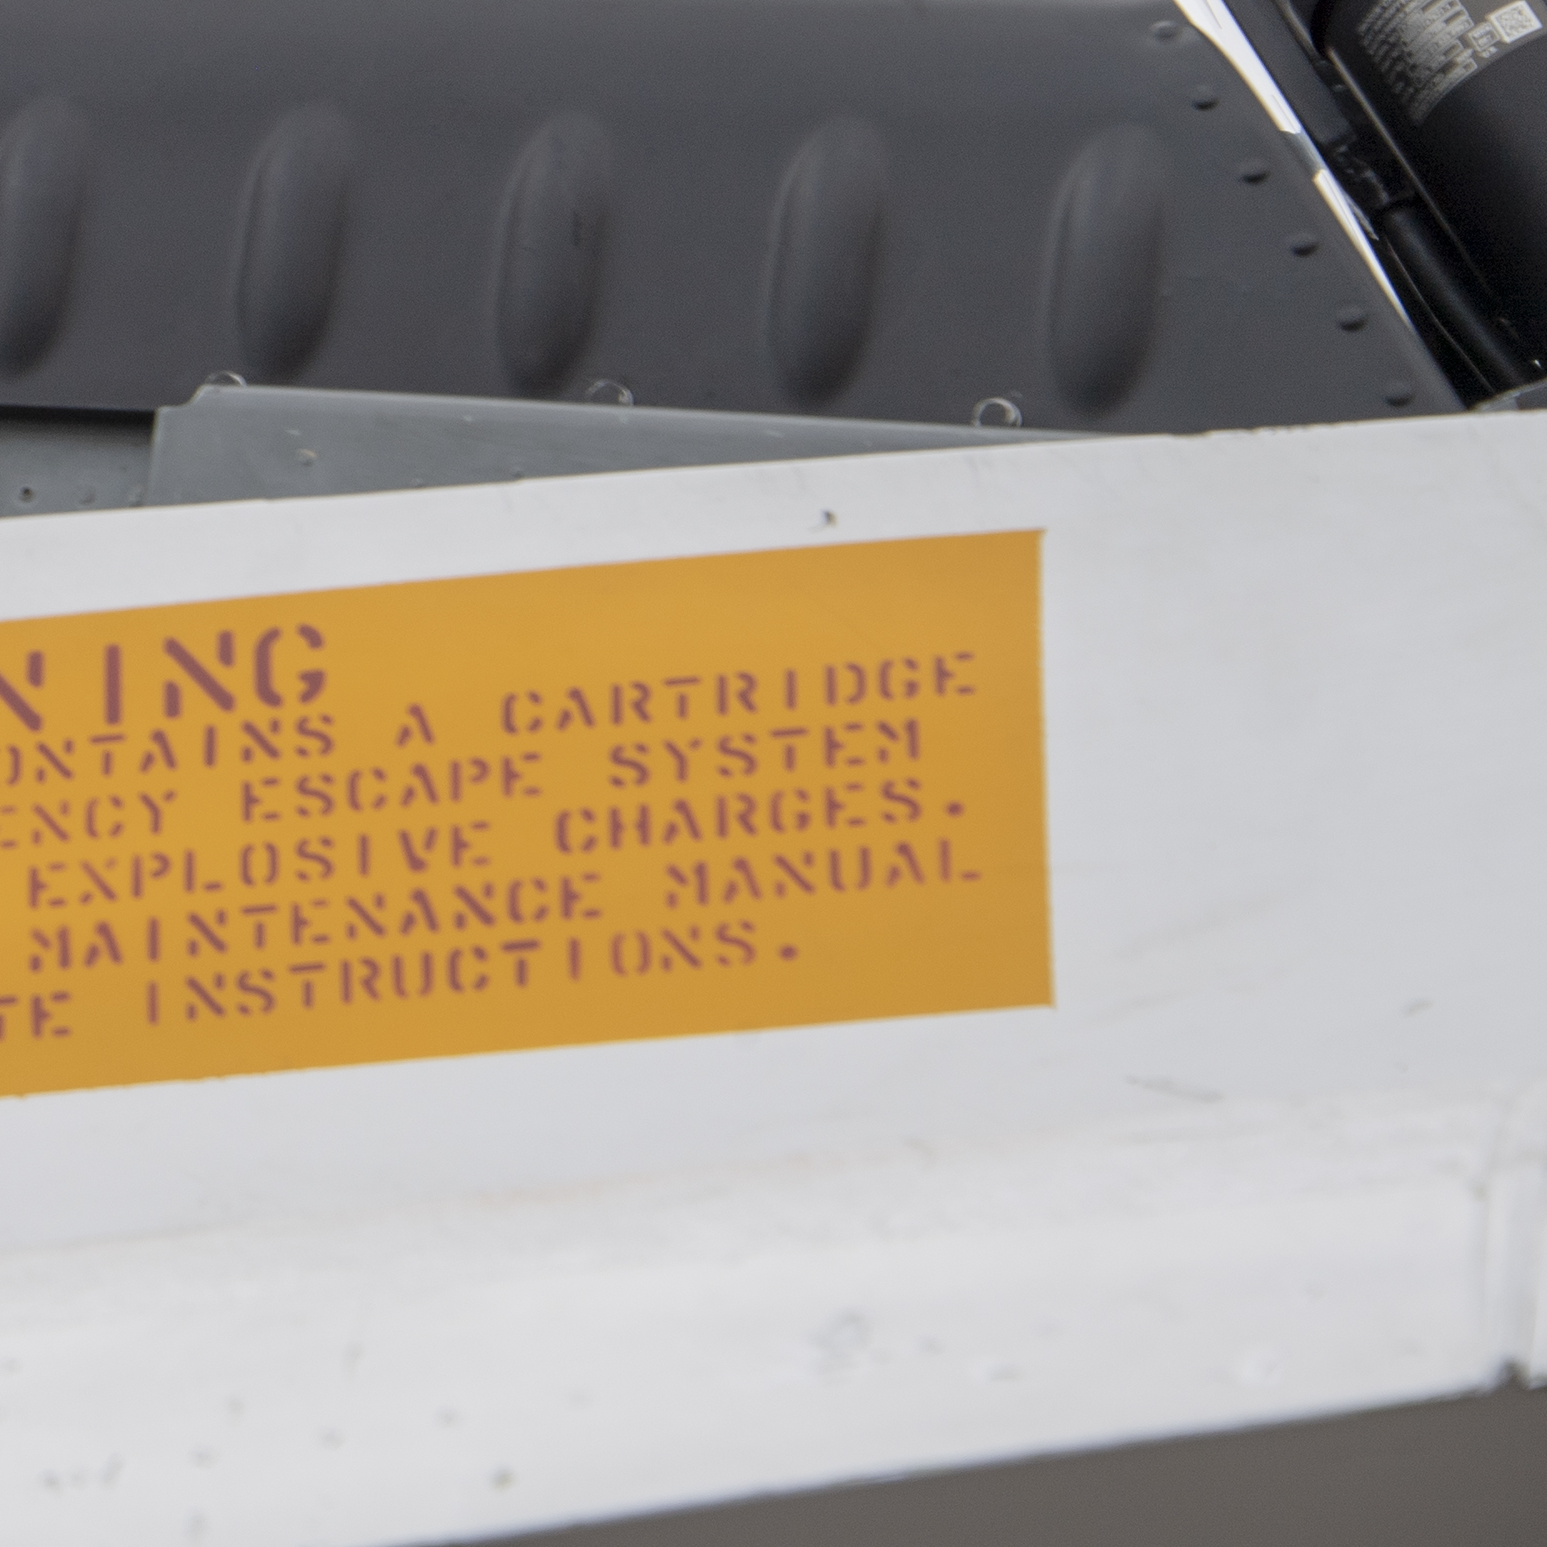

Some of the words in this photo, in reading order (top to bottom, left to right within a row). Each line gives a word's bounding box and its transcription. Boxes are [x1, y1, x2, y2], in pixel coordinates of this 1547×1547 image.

[397, 704, 434, 746] A
[502, 652, 974, 735] CARTRIDGE
[242, 752, 540, 821] ESCAPE
[610, 719, 920, 788] SYSTEM
[29, 821, 488, 908] EXPLOSIVE
[555, 778, 964, 853] CHARGES.
[29, 873, 600, 972] MAINTENANCE
[666, 840, 979, 908] MANUAL
[147, 921, 797, 1024] INSTRUCTIONS.
